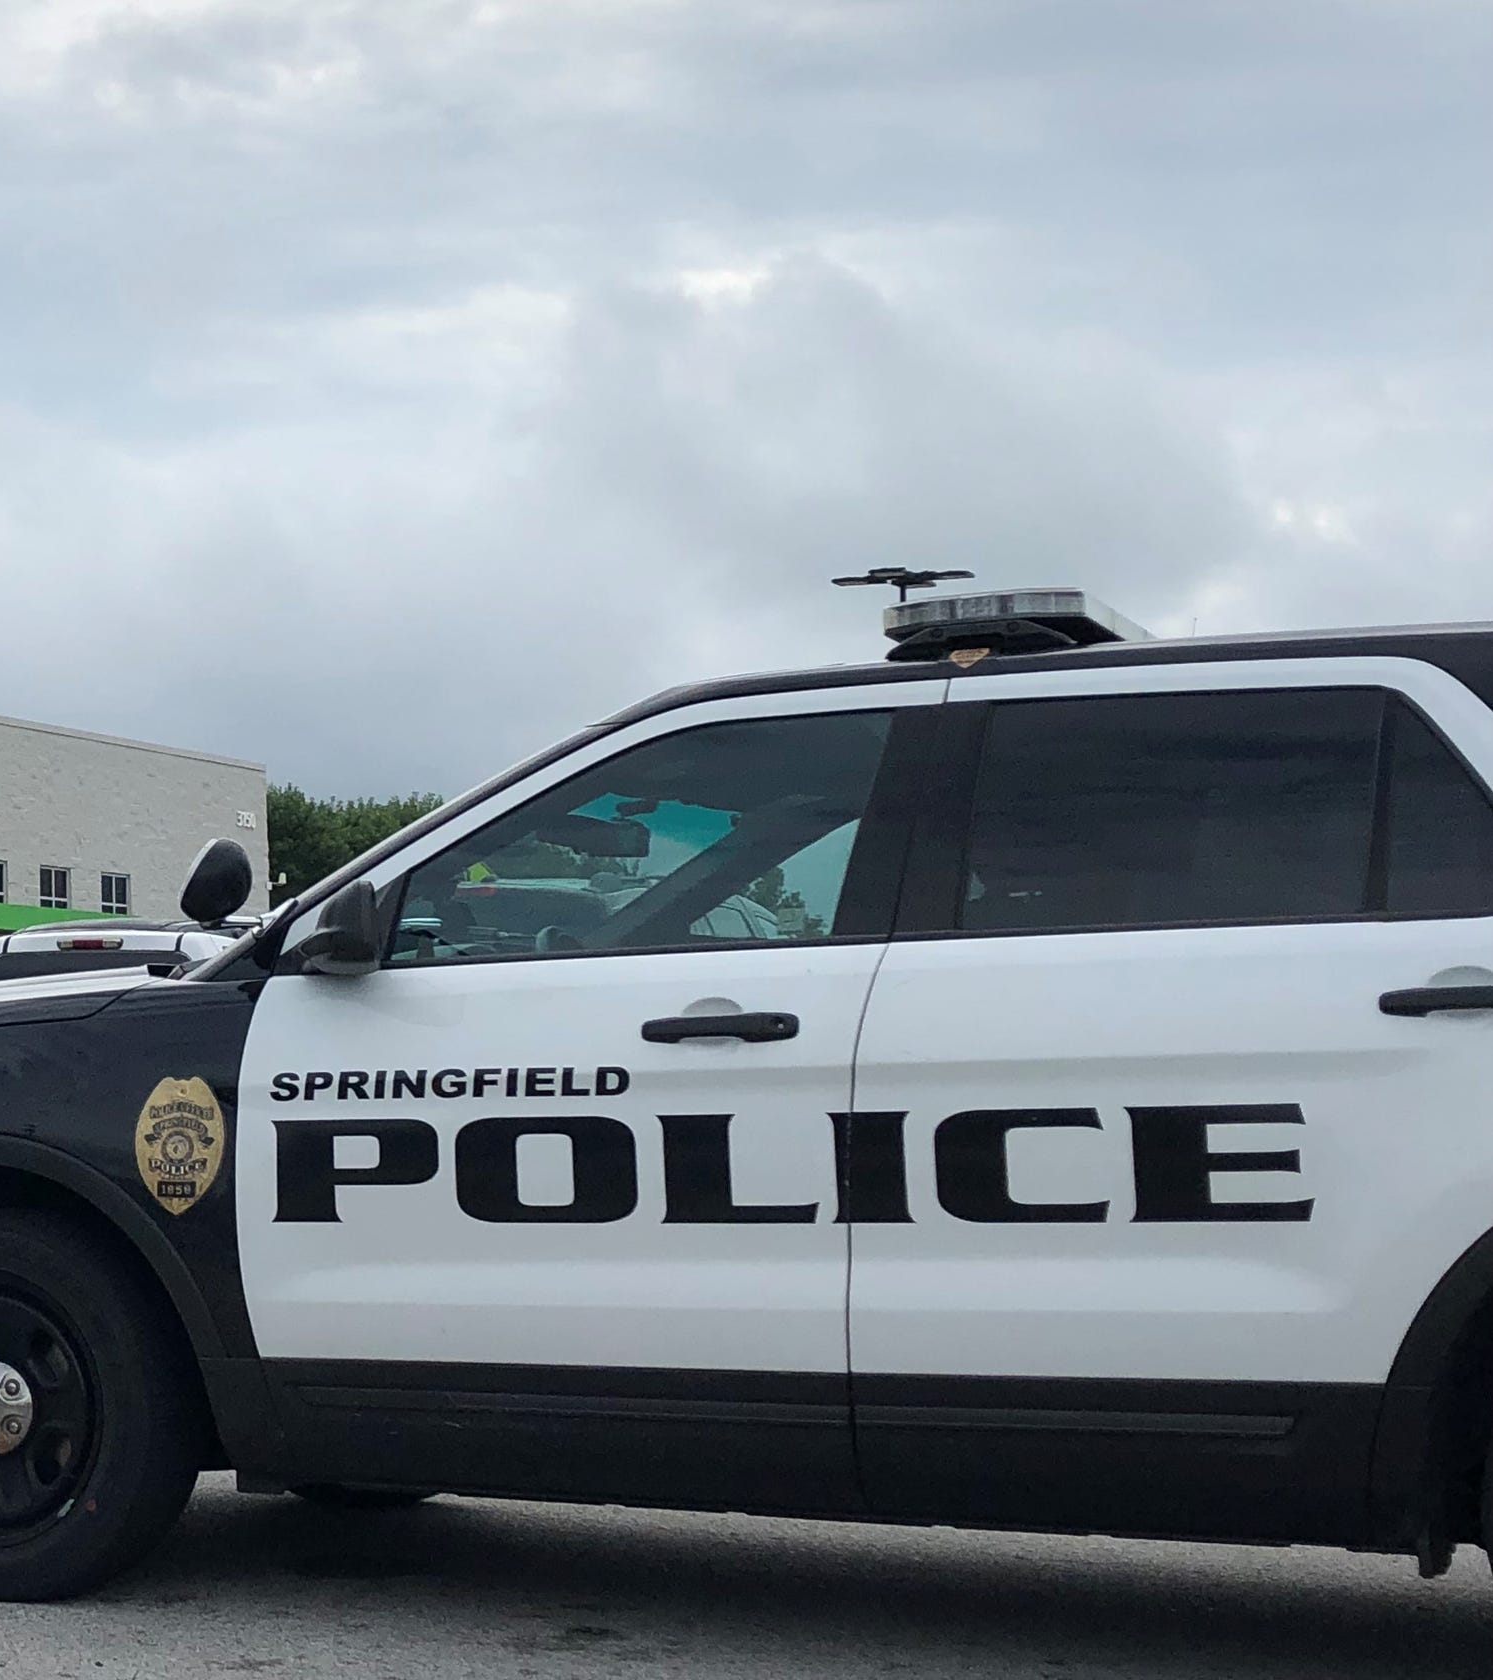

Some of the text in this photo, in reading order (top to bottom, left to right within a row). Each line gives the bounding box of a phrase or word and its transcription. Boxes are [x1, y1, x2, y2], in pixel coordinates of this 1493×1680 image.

[269, 1066, 631, 1101] SPRINGFIELD
[150, 1160, 205, 1175] POLICE
[271, 1103, 1315, 1224] POLICE
